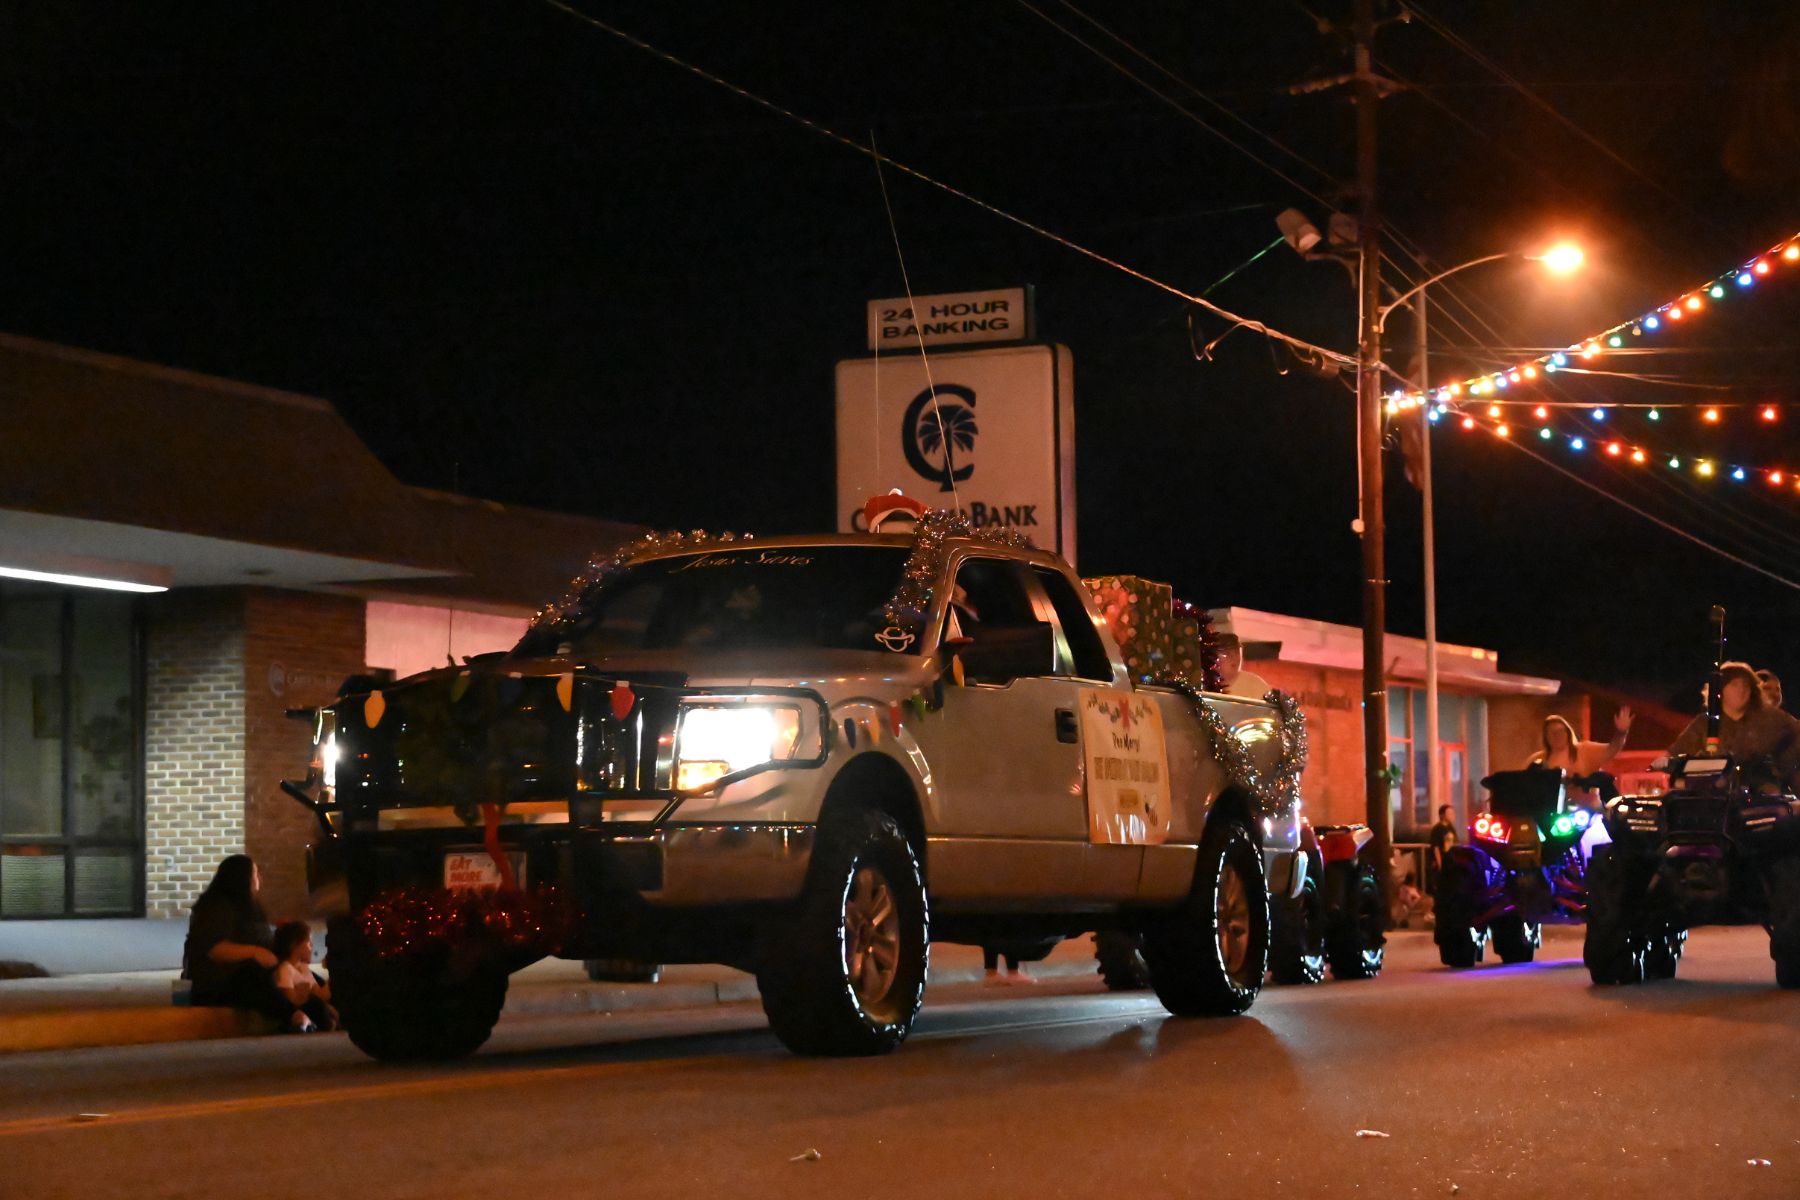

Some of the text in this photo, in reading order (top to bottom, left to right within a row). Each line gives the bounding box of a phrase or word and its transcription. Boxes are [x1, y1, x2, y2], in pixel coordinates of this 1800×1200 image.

[882, 300, 1009, 322] 24 HOUR
[882, 317, 1009, 340] BANKING
[970, 501, 1038, 529] BANK
